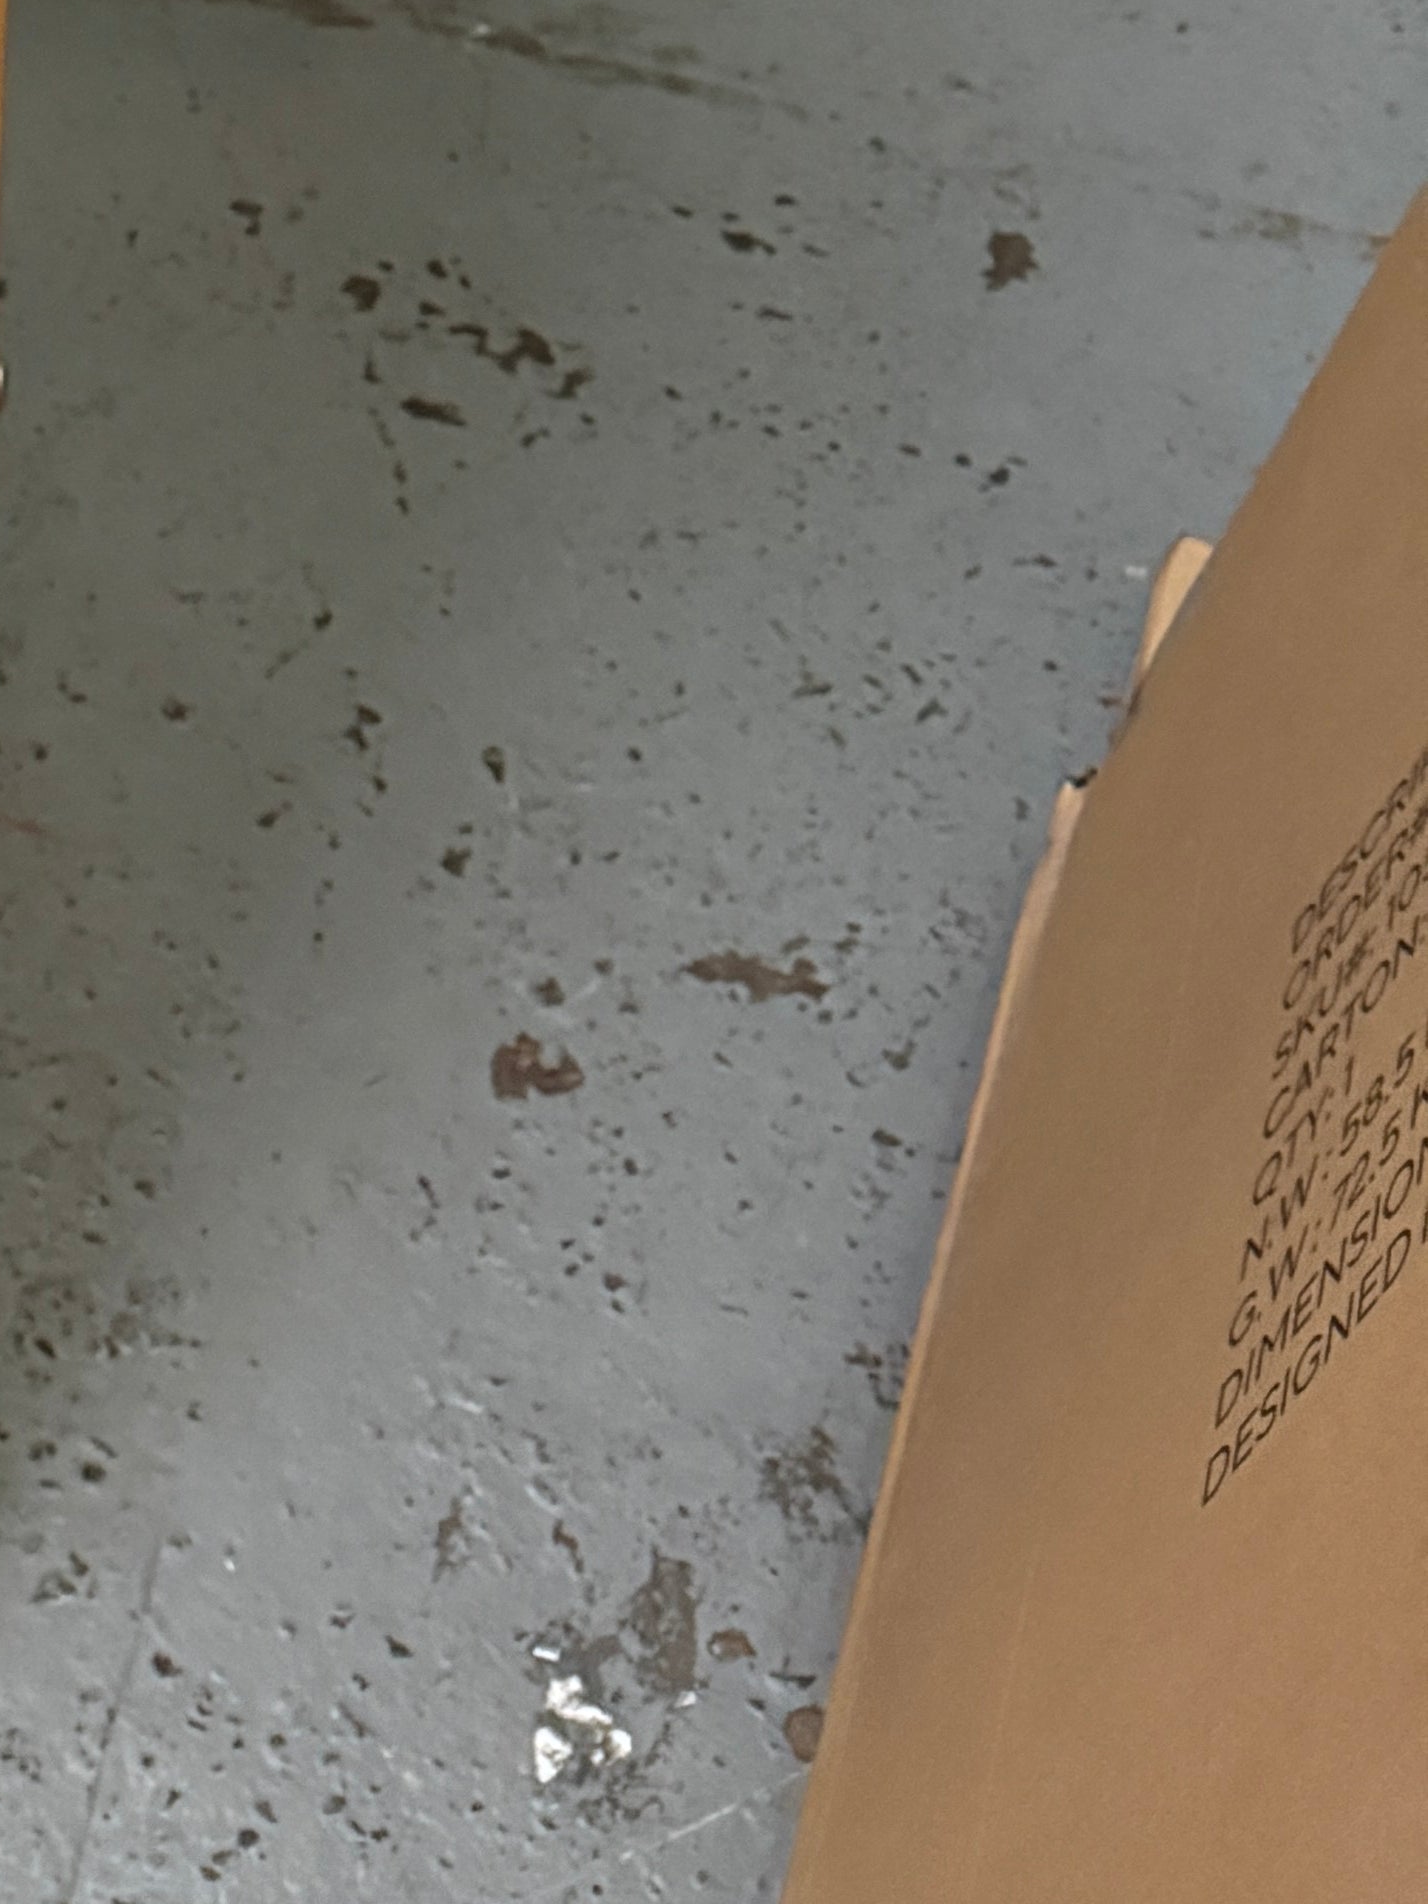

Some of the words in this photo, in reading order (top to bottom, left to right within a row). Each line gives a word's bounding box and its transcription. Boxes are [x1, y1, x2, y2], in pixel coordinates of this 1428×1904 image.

[1252, 1088, 1333, 1205] QTY:
[1345, 1056, 1355, 1095] 1
[1340, 1030, 1416, 1157] 58.5
[1330, 1109, 1402, 1233] 72.5
[1201, 1228, 1412, 1507] DESIGNED
